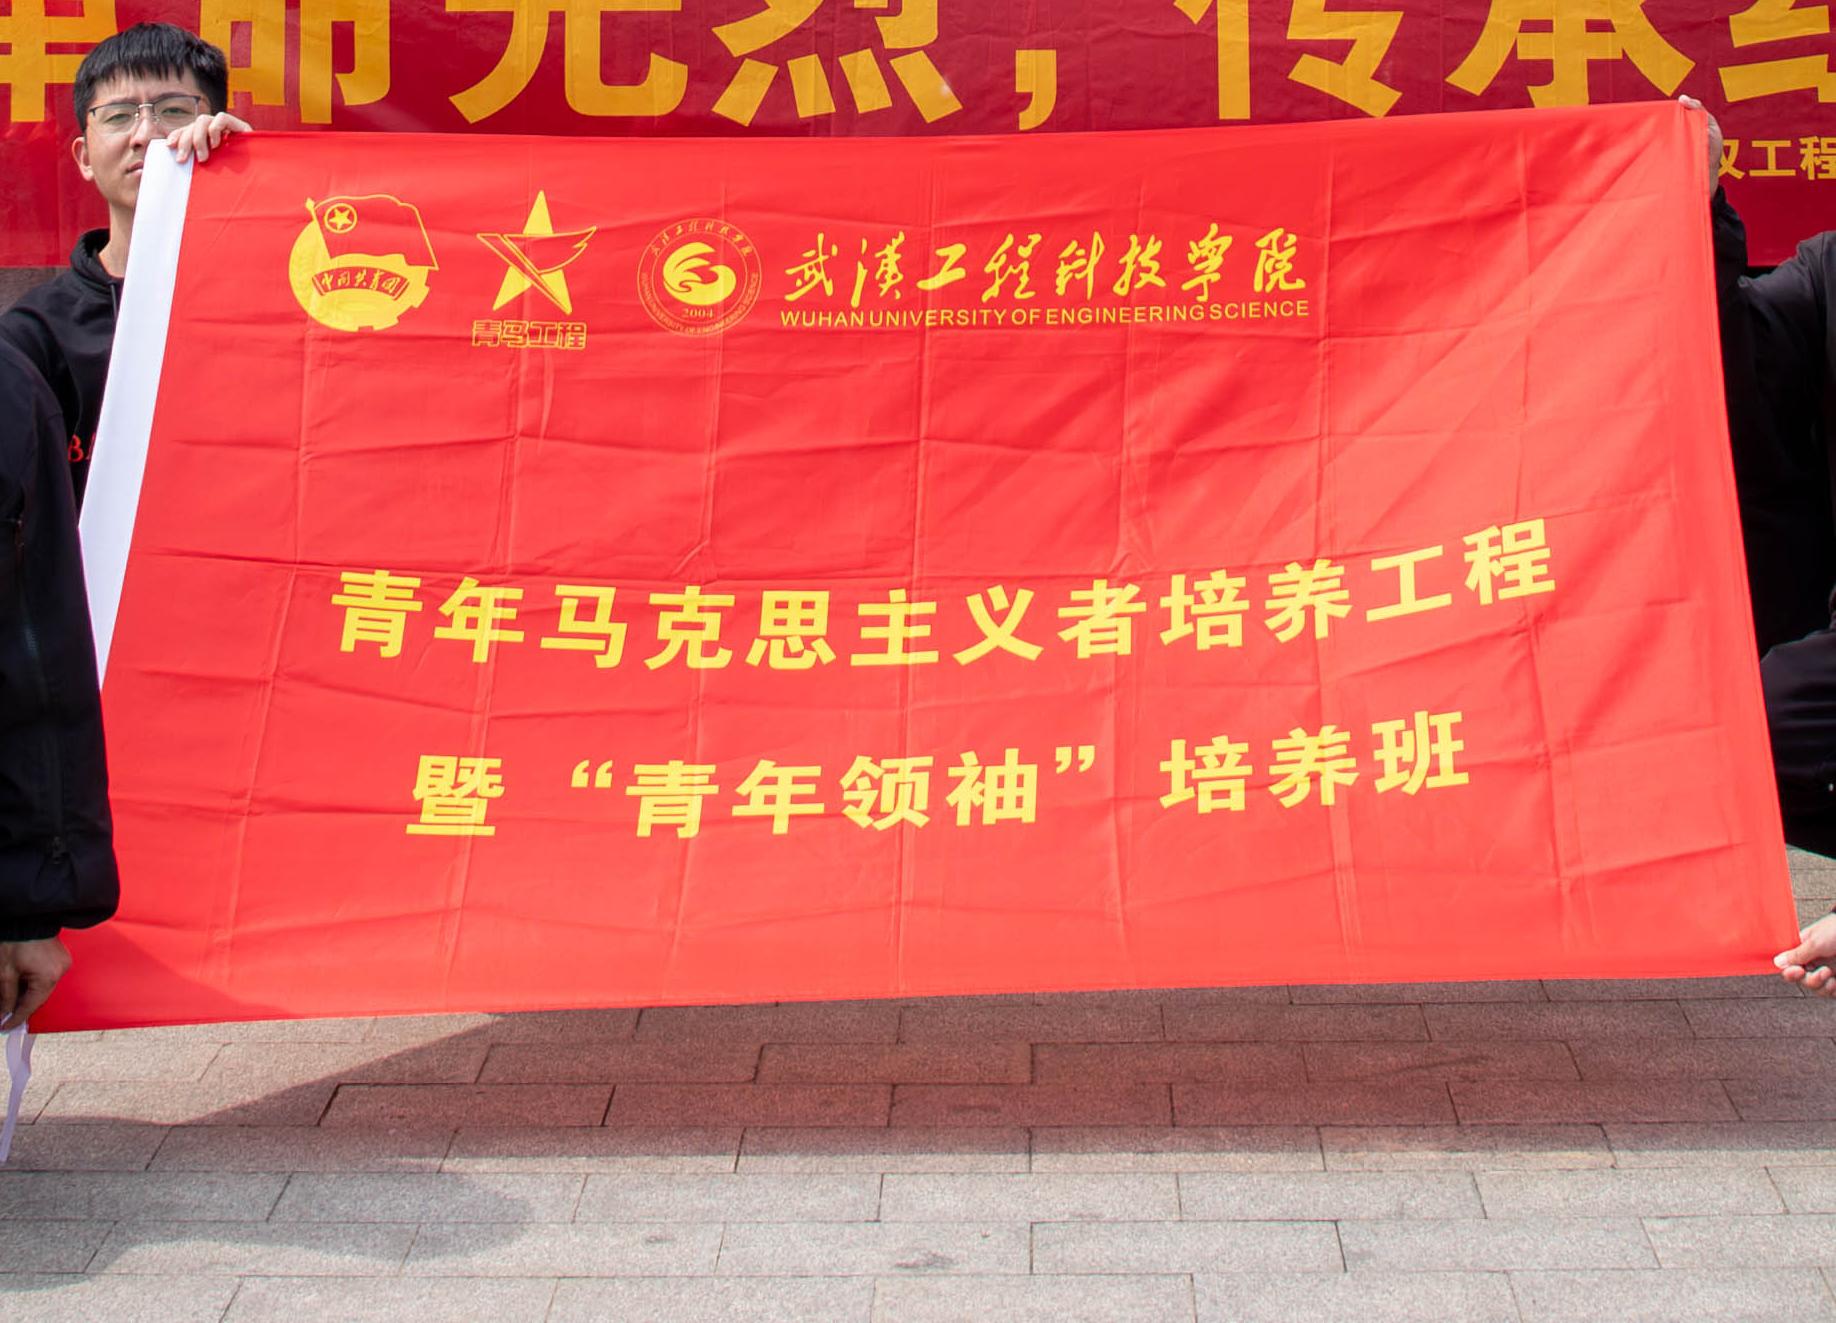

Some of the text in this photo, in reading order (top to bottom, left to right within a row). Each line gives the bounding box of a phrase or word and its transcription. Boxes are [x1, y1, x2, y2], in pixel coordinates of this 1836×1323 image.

[682, 307, 715, 319] 2004
[780, 299, 1310, 327] WUHAN UNIVERSITY OF ENGINEERING SCIENCE
[472, 319, 586, 349] 青马工程
[330, 516, 1556, 671] 青年马克思主义者培养工程
